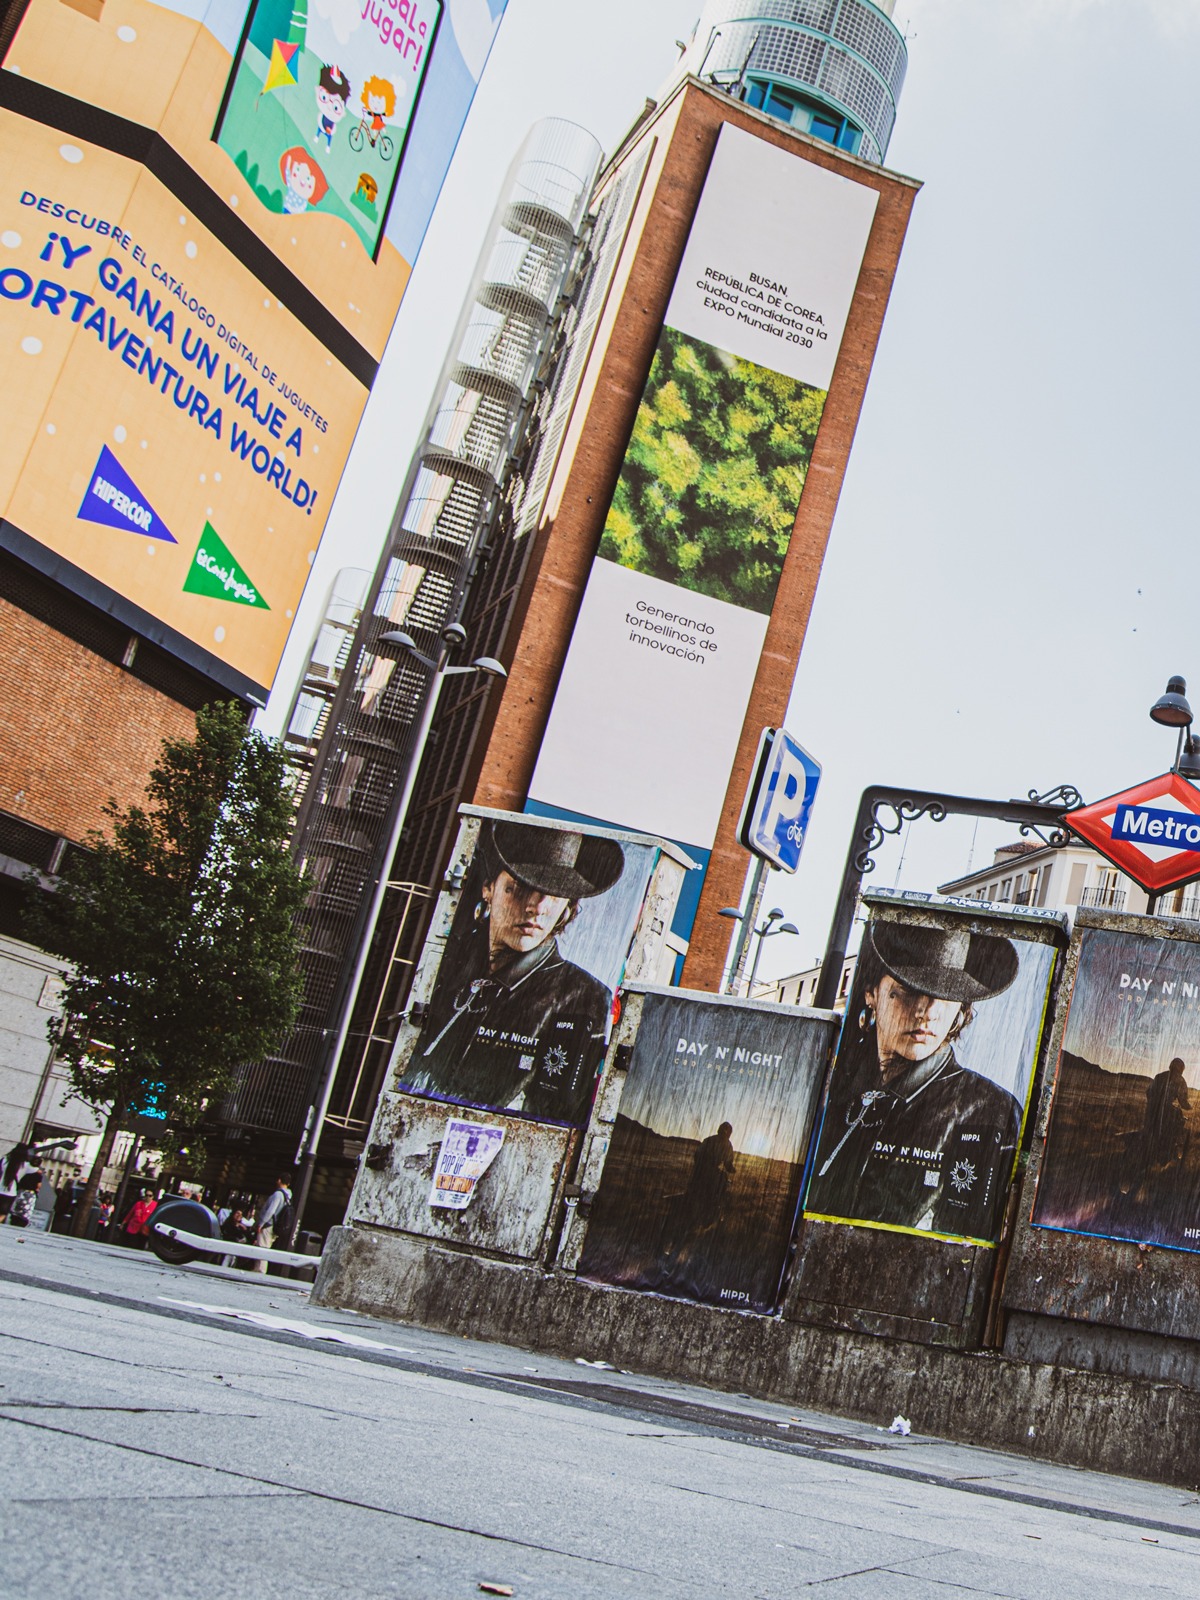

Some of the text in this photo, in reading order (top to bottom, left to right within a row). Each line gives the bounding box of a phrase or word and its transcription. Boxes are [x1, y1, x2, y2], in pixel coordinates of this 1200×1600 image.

[704, 267, 825, 326] REPÚBLICA DE COREA.
[749, 272, 788, 297] BUSAN.
[20, 191, 329, 433] DESCUBRE EL CATÁLOGO DIGITAL DE JUGUETES
[696, 280, 828, 340] ciudad candidata a la
[703, 297, 813, 349] EXPO Mundial 2030
[40, 232, 303, 457] ¡Y GANA UN VIAJE A
[230, 422, 318, 516] WORLD!
[92, 476, 152, 531] HIPERCOR
[625, 613, 718, 652] torbellinos de
[636, 600, 715, 635] Generando
[629, 630, 705, 664] innovación
[764, 748, 806, 840] P
[1119, 973, 1153, 991] DAY
[478, 1026, 497, 1038] DAY
[511, 1032, 540, 1046] NIGHT
[676, 1038, 708, 1056] DAY
[734, 1047, 782, 1068] NIGHT
[875, 1141, 896, 1154] DAY
[913, 1147, 944, 1161] NIGHT
